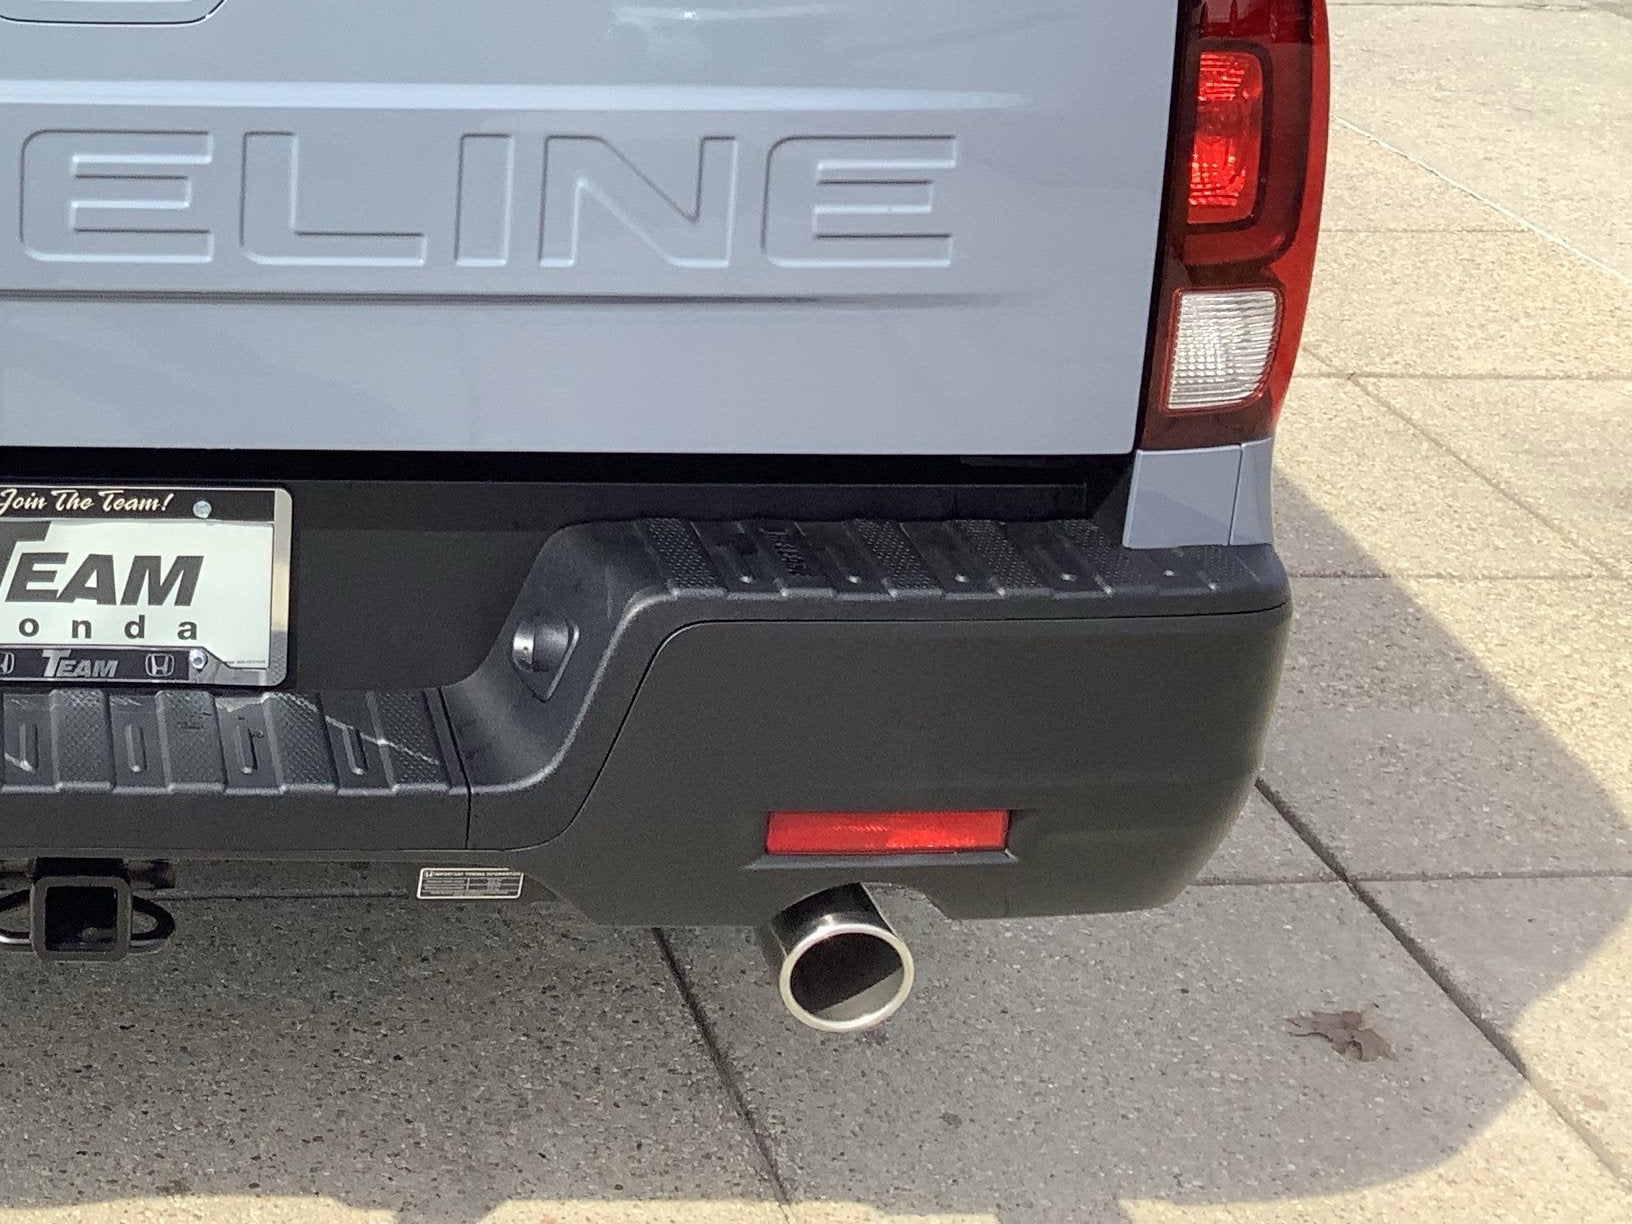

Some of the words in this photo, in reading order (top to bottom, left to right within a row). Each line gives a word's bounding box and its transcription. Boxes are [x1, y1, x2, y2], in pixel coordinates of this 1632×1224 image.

[51, 489, 96, 512] The
[97, 489, 175, 513] Team!
[41, 649, 119, 679] TEAM
